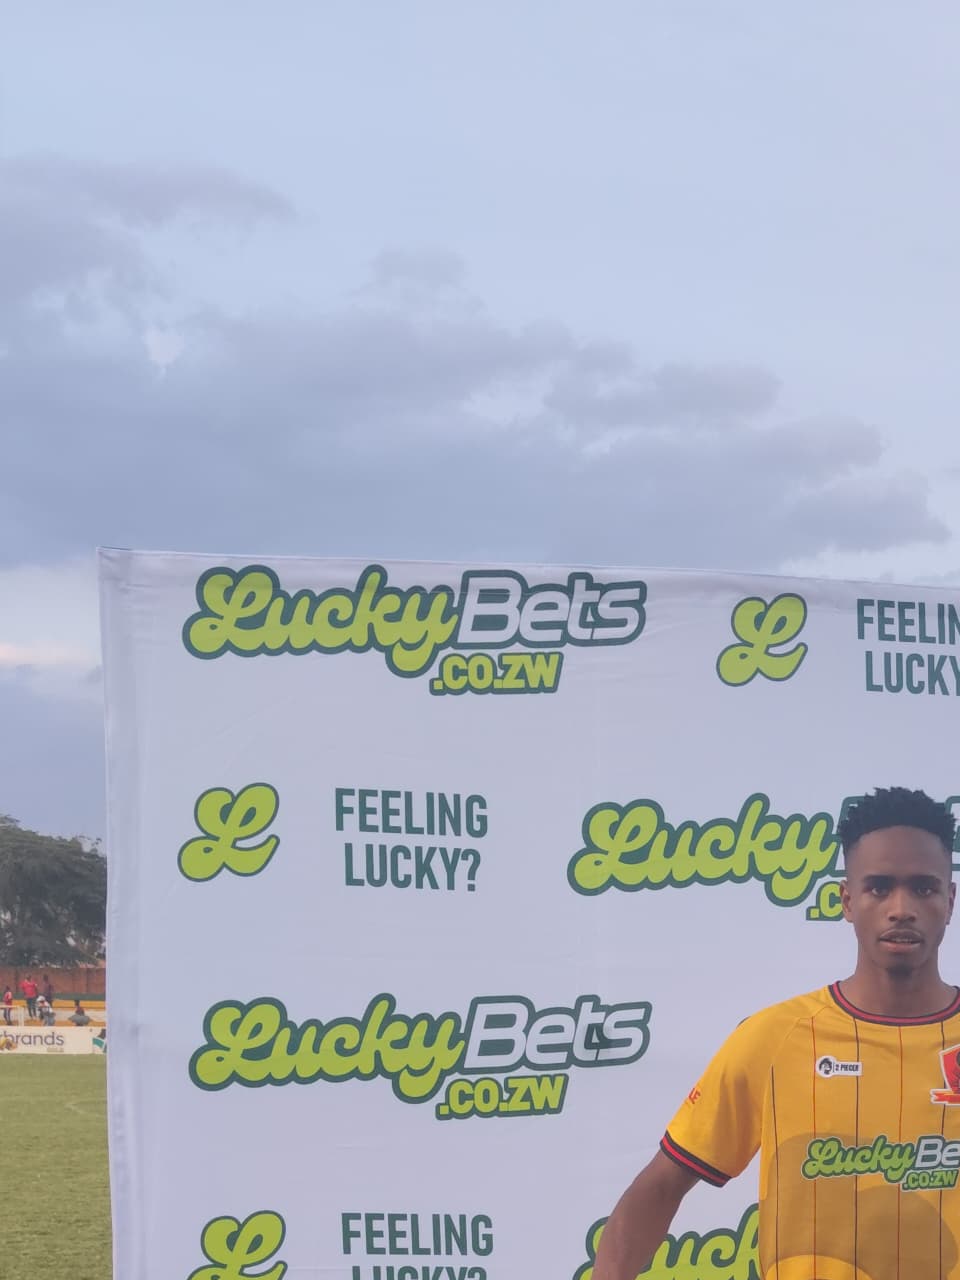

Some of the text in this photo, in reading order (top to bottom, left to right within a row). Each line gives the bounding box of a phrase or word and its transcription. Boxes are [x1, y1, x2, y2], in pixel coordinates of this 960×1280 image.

[183, 565, 646, 677] LuckyBets
[430, 652, 562, 694] .CO.ZW
[335, 787, 488, 838] FEELING
[344, 842, 481, 892] LUCKY?
[190, 994, 652, 1104] LuckyBets
[436, 1073, 568, 1120] .CO.ZW
[903, 1169, 958, 1191] .CO.ZW
[341, 1212, 494, 1257] FEELING
